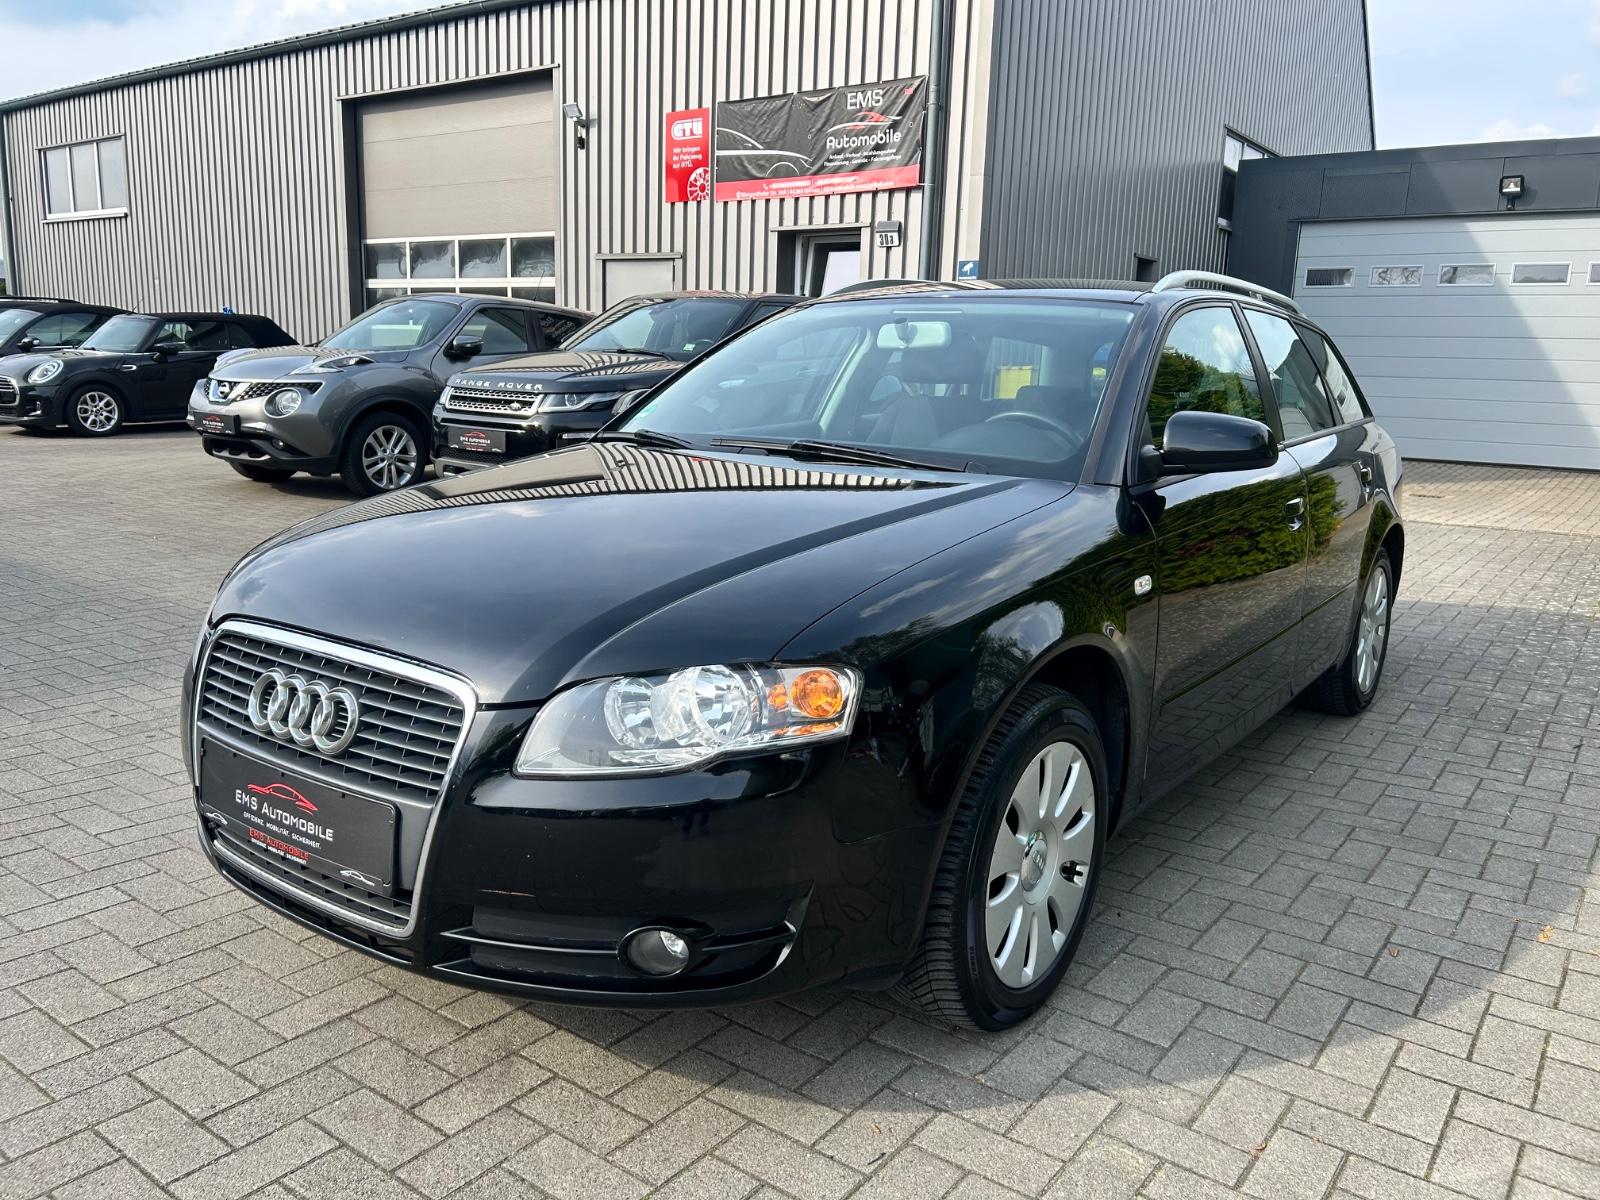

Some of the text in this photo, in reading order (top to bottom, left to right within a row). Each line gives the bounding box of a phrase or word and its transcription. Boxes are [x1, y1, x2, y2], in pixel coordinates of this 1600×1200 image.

[847, 89, 883, 110] EMS
[826, 128, 902, 149] Automobile
[879, 233, 894, 246] 30a
[455, 379, 543, 390] RANGE ROVER
[235, 789, 334, 841] EMS AUTOMOBILE
